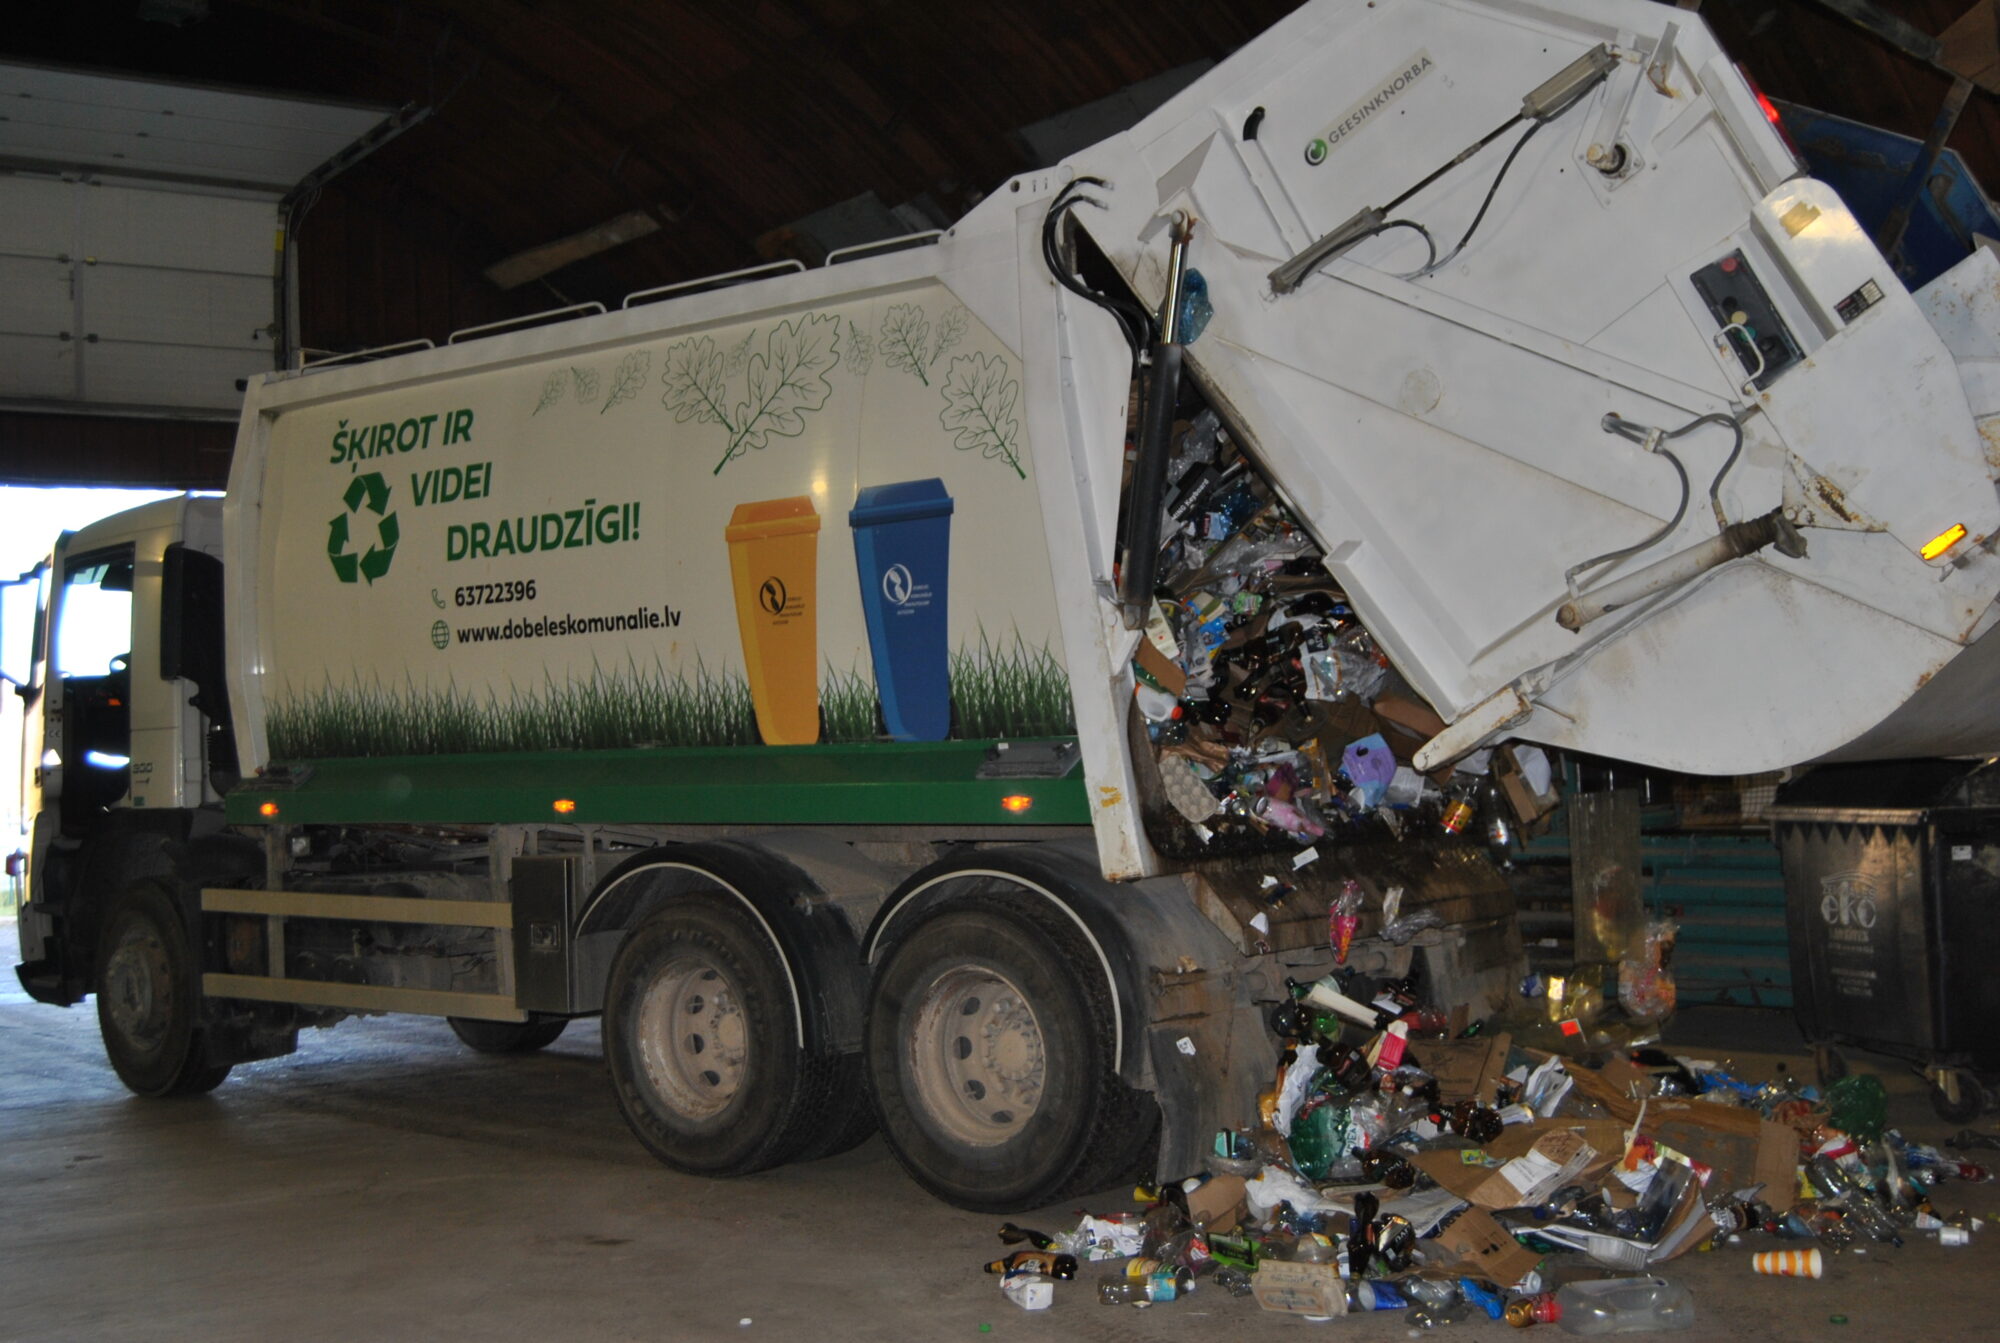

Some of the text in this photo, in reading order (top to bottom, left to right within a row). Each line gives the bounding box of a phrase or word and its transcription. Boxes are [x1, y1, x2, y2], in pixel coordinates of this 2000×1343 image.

[1328, 57, 1432, 144] GEESINKNORBA
[330, 408, 474, 473] ŠĶIROT IR
[411, 461, 493, 507] VIDEI
[446, 498, 641, 562] DRAUDZĪGI!
[454, 579, 537, 607] 63722396
[457, 605, 682, 643] www.dobeleskomunalie.lv
